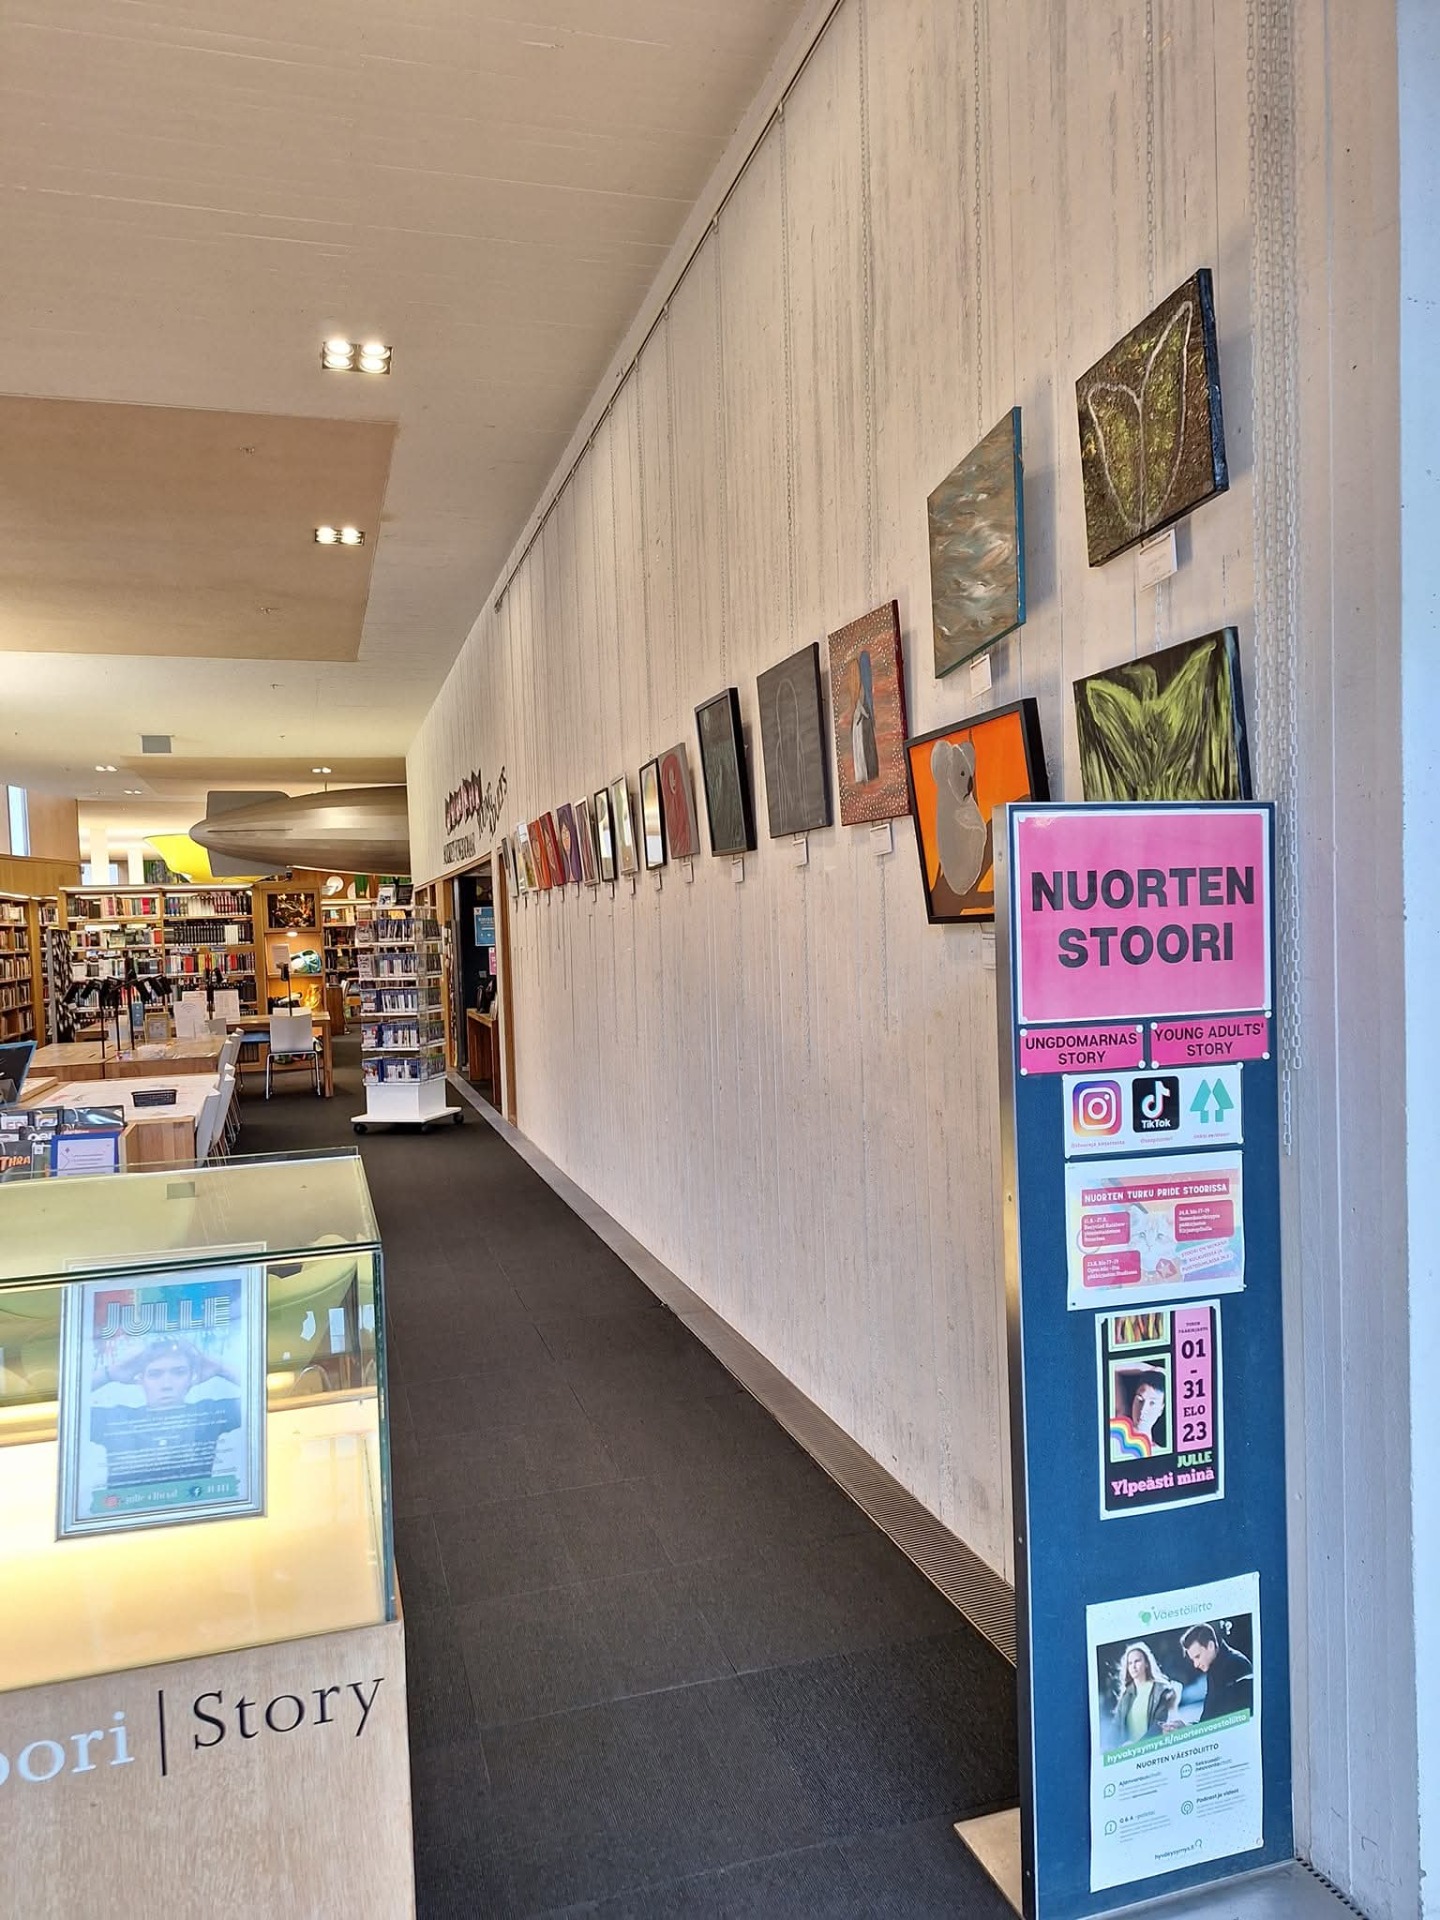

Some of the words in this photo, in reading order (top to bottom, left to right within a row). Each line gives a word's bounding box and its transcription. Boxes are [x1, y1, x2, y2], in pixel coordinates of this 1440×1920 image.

[1031, 866, 1254, 911] NUORTEN
[1058, 922, 1233, 968] STOORI
[1025, 1032, 1137, 1050] UNGDOMARNAS
[1154, 1027, 1204, 1041] YOUNG
[1058, 1050, 1106, 1065] STORY
[1186, 1041, 1233, 1057] STORY
[1141, 1117, 1171, 1129] TikTok
[1084, 1189, 1124, 1203] NUORTEN
[1127, 1187, 1154, 1199] TURKU
[1157, 1186, 1180, 1197] PRIDE
[1183, 1183, 1227, 1195] STOORISSA
[101, 1295, 231, 1340] JULLE
[1181, 1339, 1206, 1359] 01
[1183, 1379, 1206, 1399] 31
[1183, 1404, 1206, 1417] ELO
[1182, 1421, 1207, 1443] 23
[1177, 1450, 1212, 1468] JULLE
[1111, 1471, 1174, 1498] Ylpeästi
[1177, 1467, 1215, 1486] minä
[0, 1711, 135, 1787] ori
[193, 1677, 385, 1750] Story
[1136, 1755, 1171, 1770] NUORTEN
